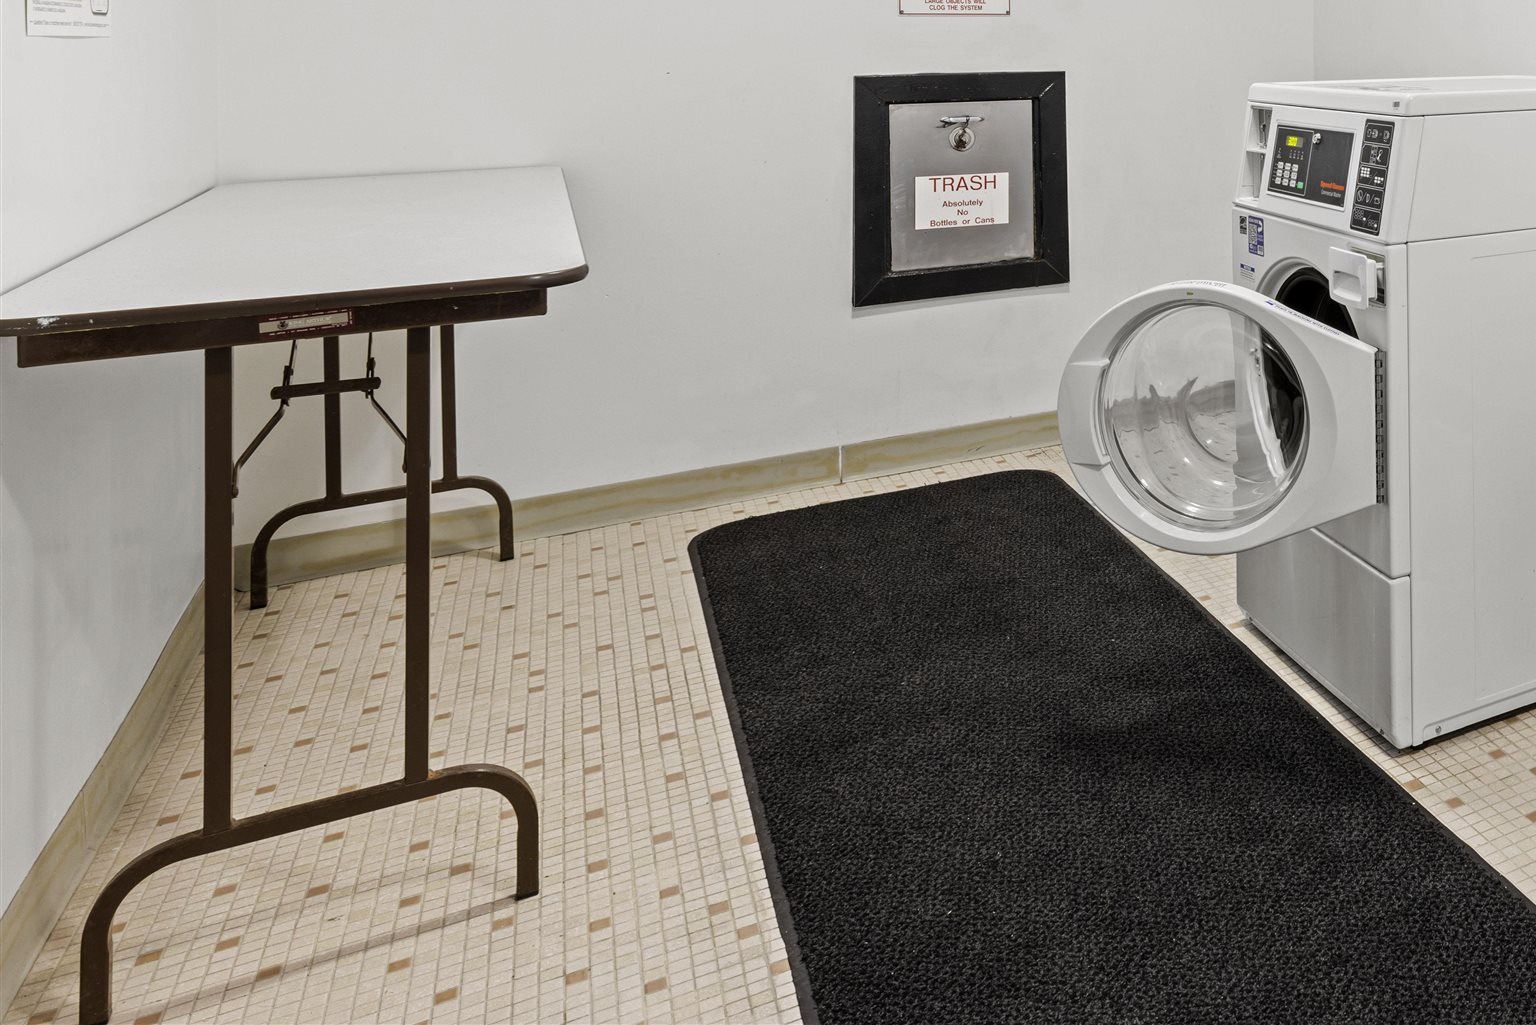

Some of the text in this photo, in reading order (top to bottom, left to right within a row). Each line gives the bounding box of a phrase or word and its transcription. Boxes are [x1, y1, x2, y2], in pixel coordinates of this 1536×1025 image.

[929, 175, 997, 193] TRASH
[942, 198, 983, 208] Absolutely
[930, 219, 957, 227] Bottles
[975, 216, 994, 224] Cans
